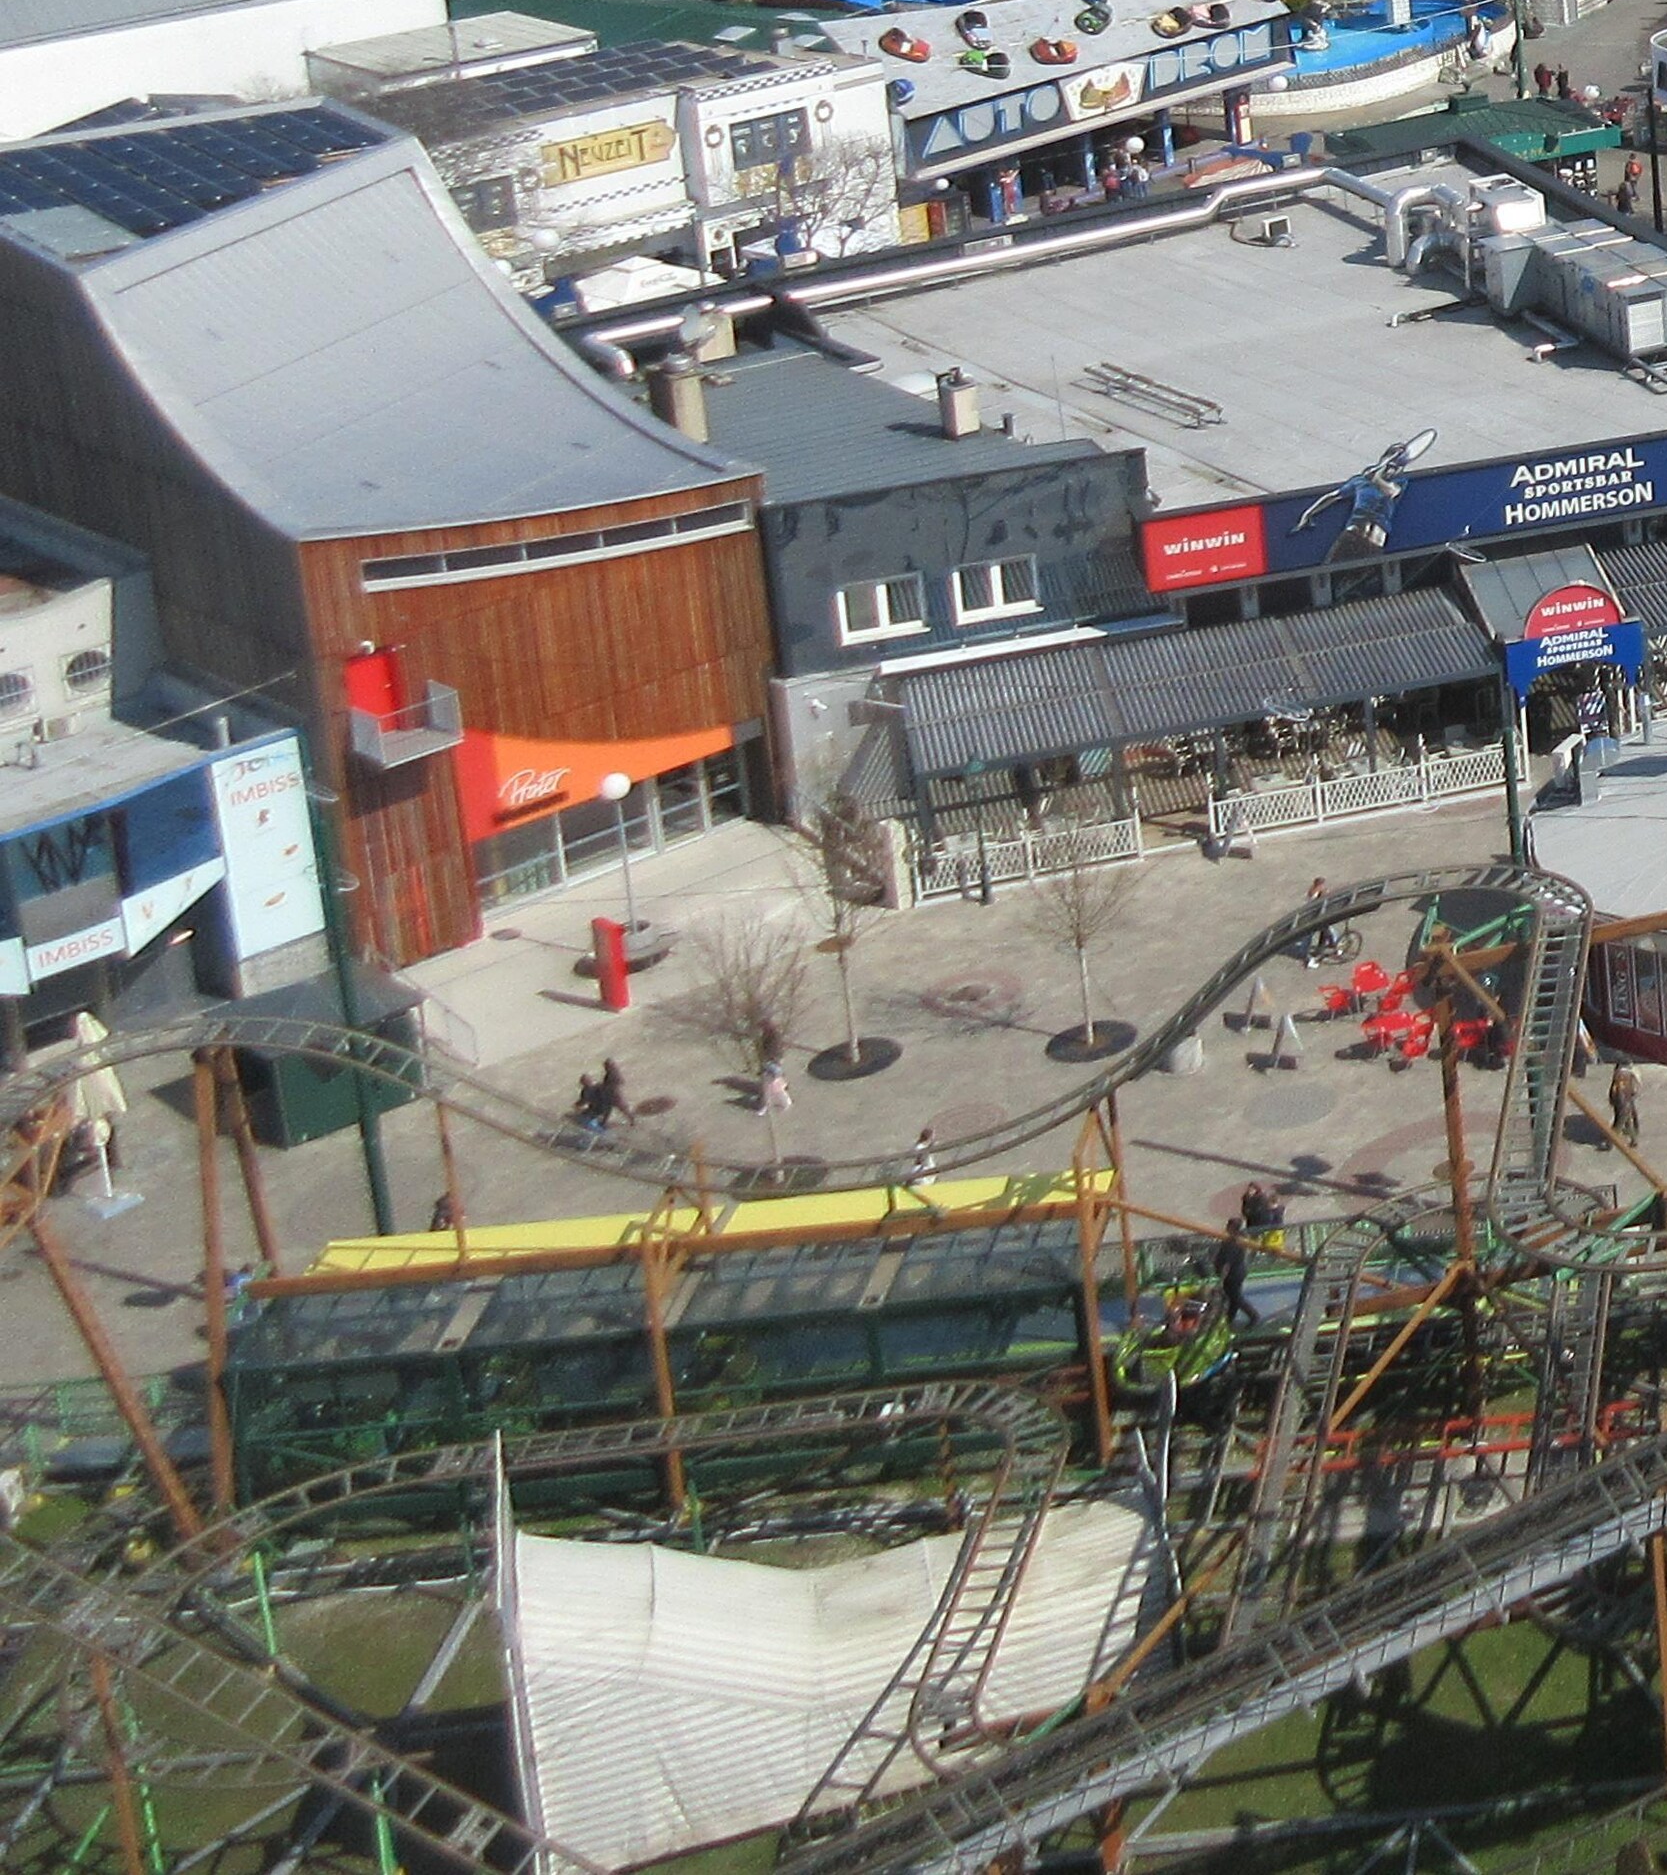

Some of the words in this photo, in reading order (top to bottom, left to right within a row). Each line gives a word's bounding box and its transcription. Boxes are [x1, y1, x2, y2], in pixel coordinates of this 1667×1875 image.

[922, 82, 1061, 159] AUTO
[1149, 21, 1274, 92] DROM
[1509, 447, 1646, 488] ADMIRAL
[1523, 470, 1633, 500] SPORTSBAR
[1504, 481, 1654, 526] HOMMERSON
[1536, 643, 1614, 668] HOMMERSON
[1540, 627, 1609, 649] ADMIRAL
[230, 770, 302, 807] IMBISS
[37, 928, 114, 969] IMBISS
